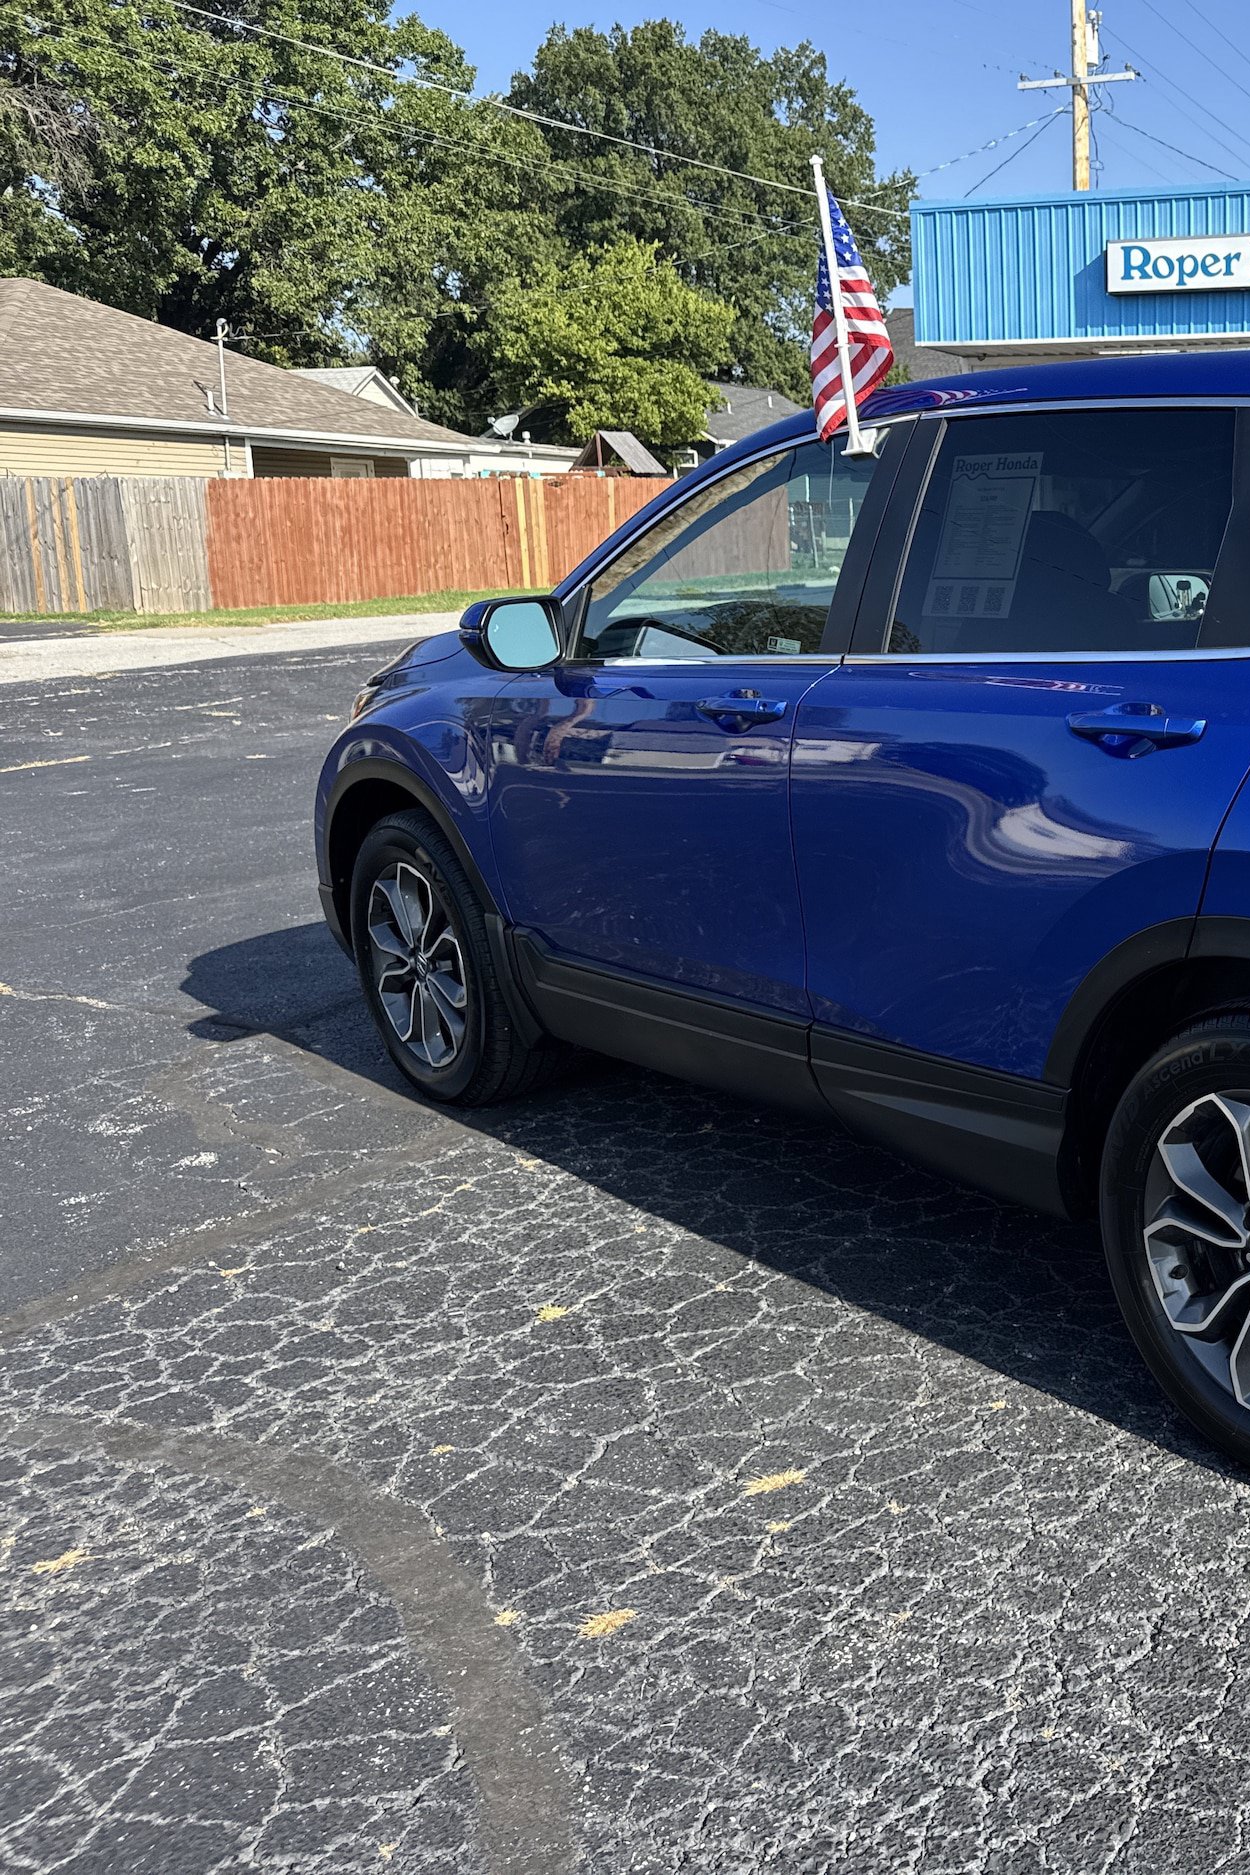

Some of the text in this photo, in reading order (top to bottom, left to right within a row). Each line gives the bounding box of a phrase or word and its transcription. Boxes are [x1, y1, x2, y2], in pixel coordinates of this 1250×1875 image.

[1120, 245, 1242, 286] Roper
[955, 456, 1039, 474] Roper Honda
[1143, 1045, 1205, 1100] Ascend
